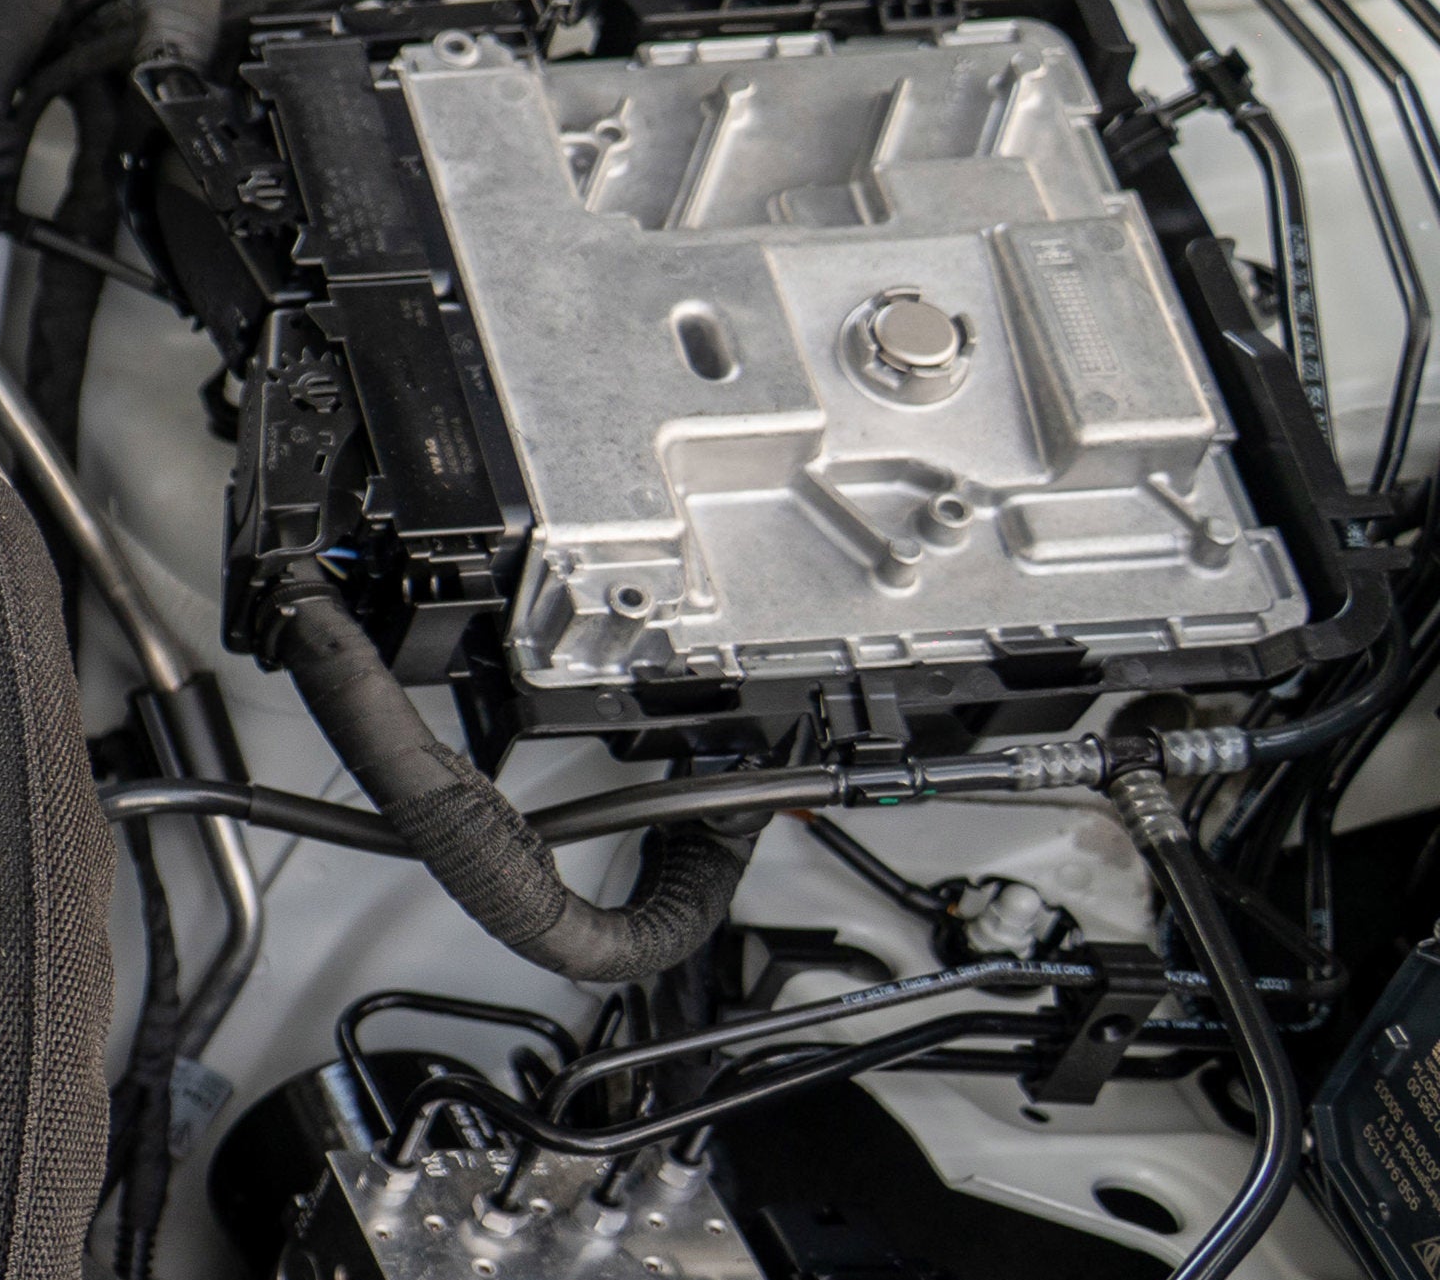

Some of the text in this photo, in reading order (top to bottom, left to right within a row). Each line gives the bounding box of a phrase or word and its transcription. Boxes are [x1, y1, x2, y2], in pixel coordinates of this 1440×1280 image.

[840, 982, 896, 1006] Porsche
[899, 975, 932, 993] Made
[938, 971, 956, 984] in
